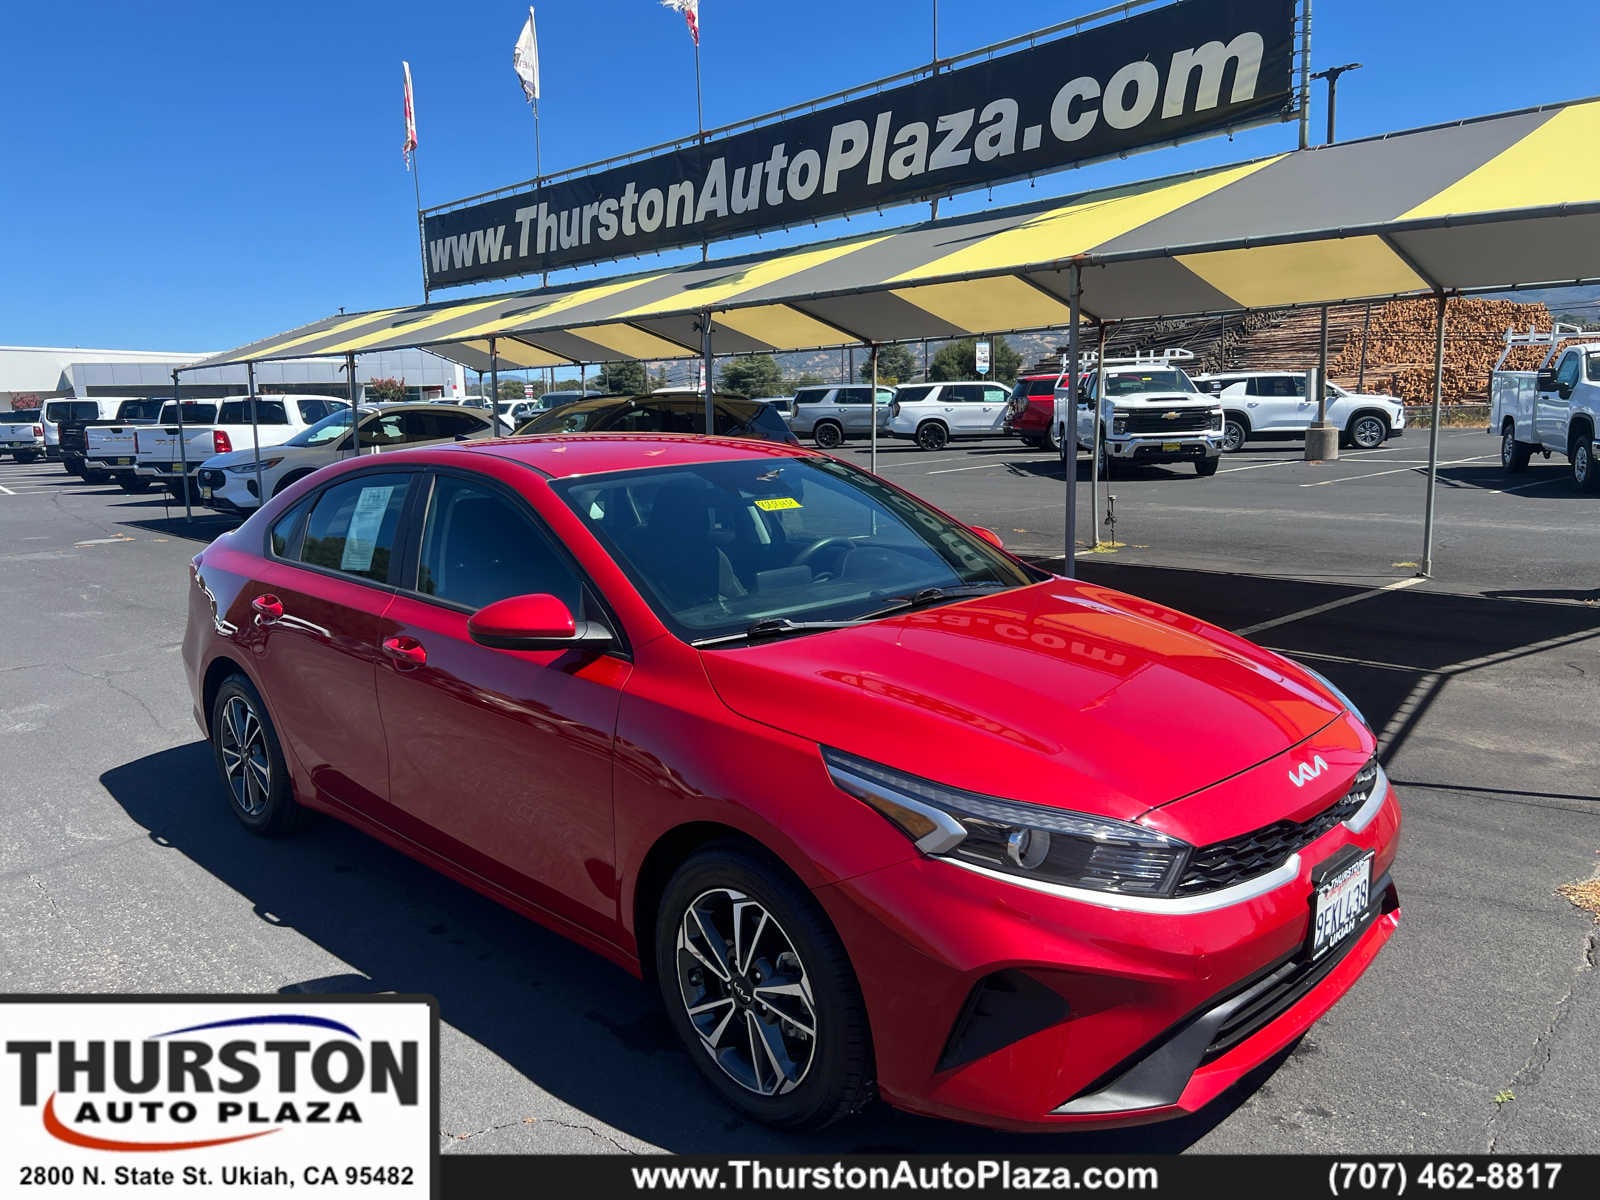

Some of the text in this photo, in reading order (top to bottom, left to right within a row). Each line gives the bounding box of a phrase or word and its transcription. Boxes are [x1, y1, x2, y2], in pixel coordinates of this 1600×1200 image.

[430, 31, 1264, 273] www.ThurstonAutoPlaza.com
[1289, 755, 1328, 787] KIA
[1315, 879, 1367, 947] 9EKL438
[1329, 919, 1355, 947] UKIAH
